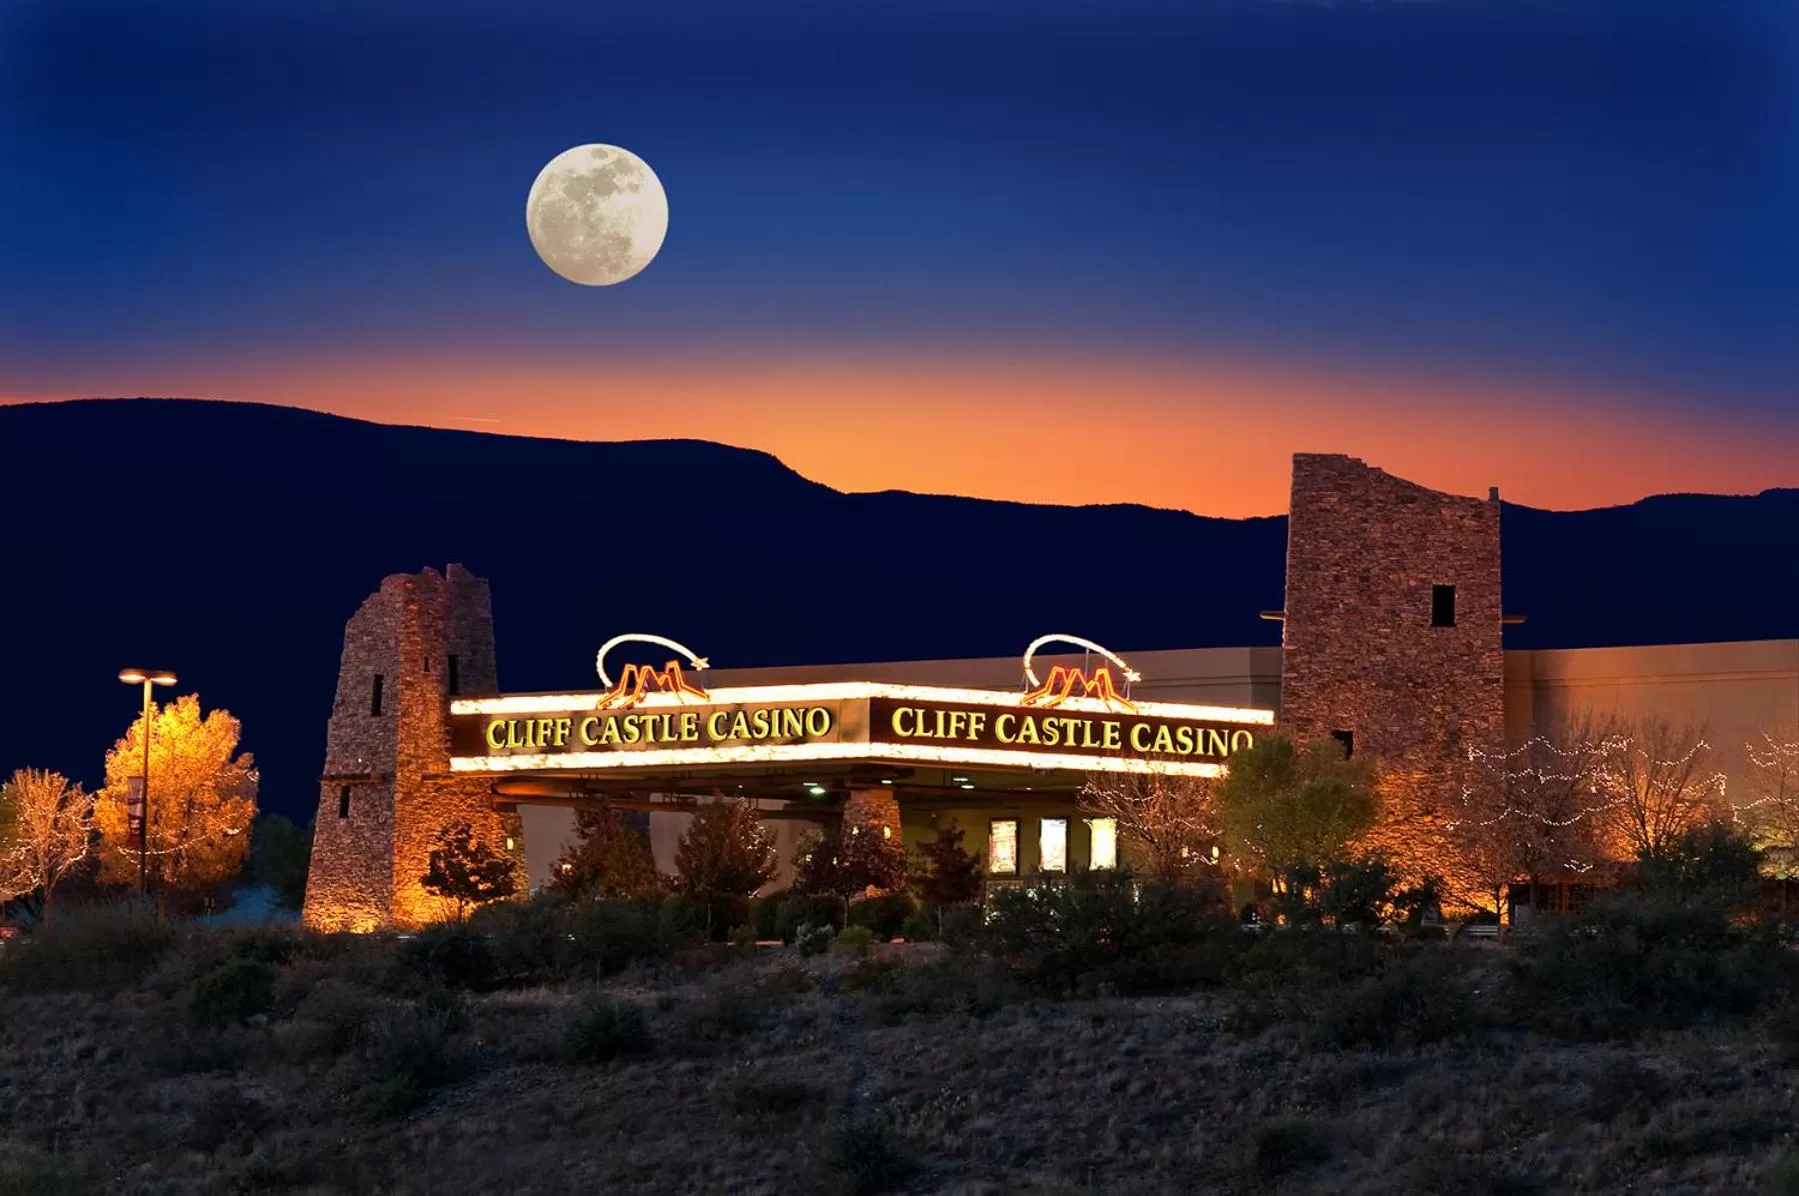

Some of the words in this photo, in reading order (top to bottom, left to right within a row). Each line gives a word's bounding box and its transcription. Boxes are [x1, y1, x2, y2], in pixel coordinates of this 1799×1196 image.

[486, 718, 573, 748] CLIFF
[579, 713, 699, 746] CASTLE
[706, 707, 832, 739] CASINO
[891, 707, 985, 740] CLIFF
[995, 714, 1122, 749] CASTLE
[1130, 723, 1254, 756] CASINO
